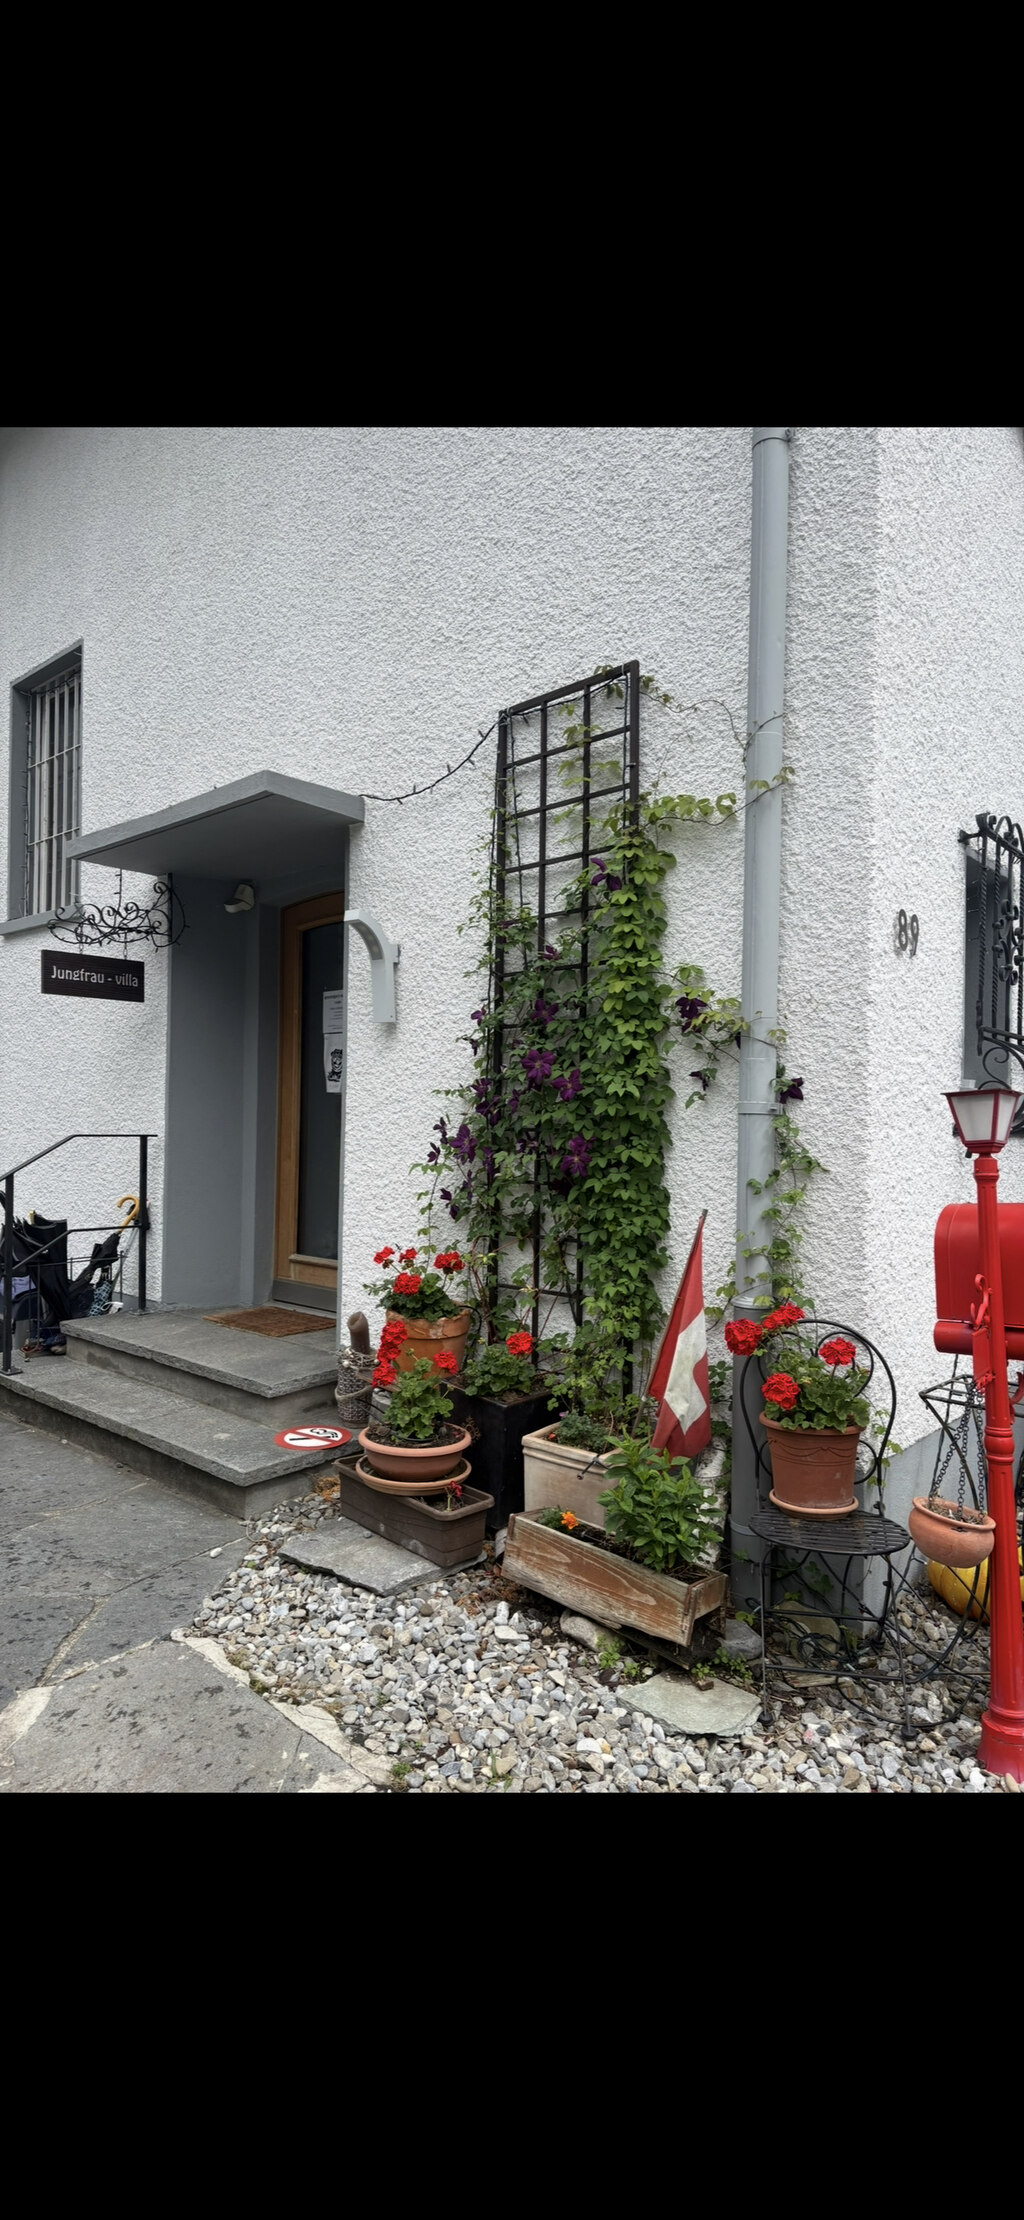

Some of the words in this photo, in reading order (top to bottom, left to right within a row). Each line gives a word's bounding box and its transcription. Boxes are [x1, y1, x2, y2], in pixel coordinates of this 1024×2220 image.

[898, 908, 919, 956] 89
[51, 965, 105, 984] Jungfrau
[115, 973, 139, 987] villa
